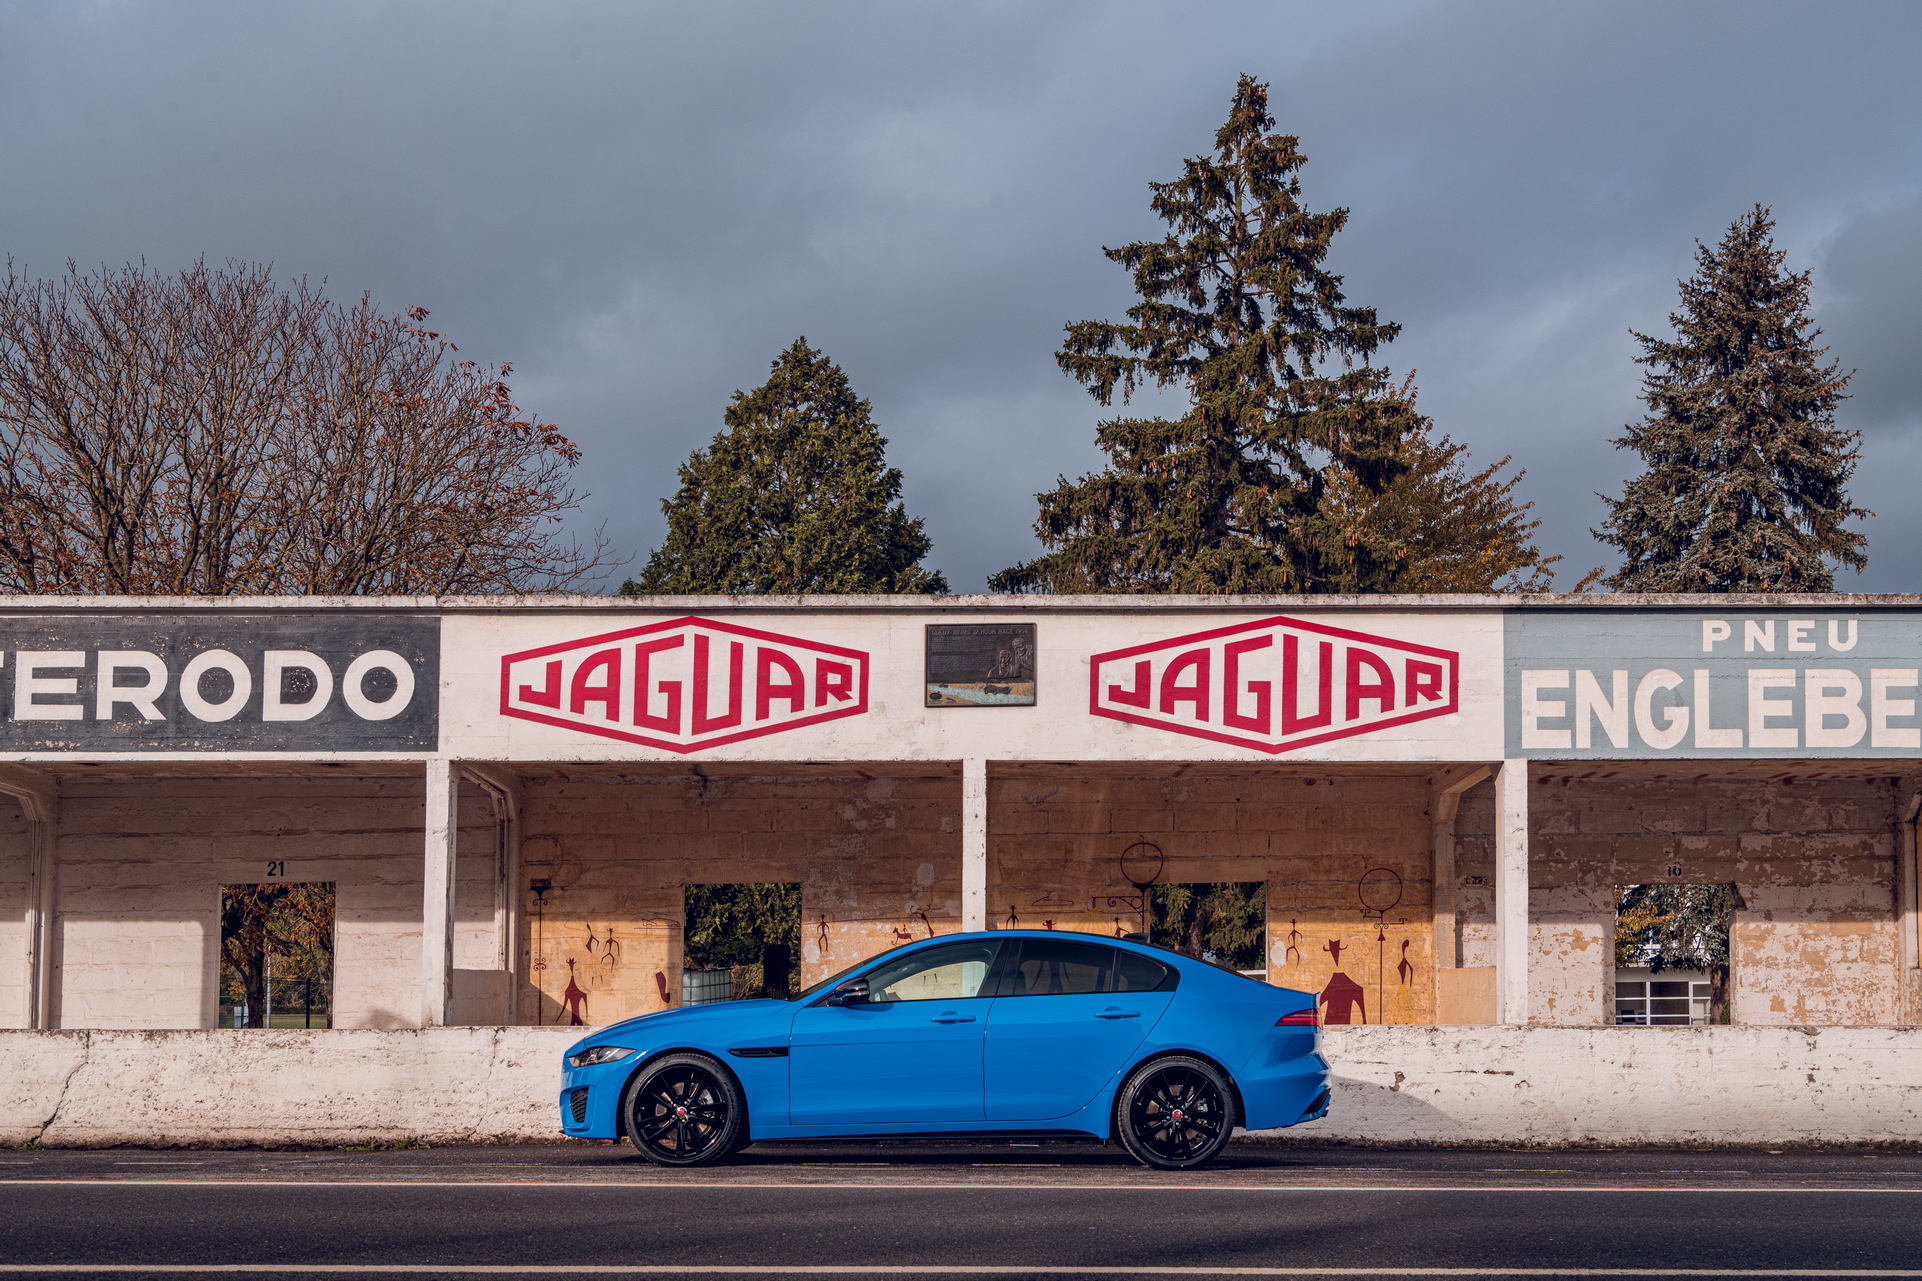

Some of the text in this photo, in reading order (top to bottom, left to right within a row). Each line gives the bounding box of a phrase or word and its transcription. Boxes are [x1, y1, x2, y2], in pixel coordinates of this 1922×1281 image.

[1702, 619, 1859, 652] PNEU
[0, 649, 415, 722] ERODO
[518, 633, 854, 736] JAGUAR
[1108, 633, 1444, 736] JAGUAR
[1521, 668, 1921, 750] ENGLEBE
[267, 861, 285, 877] 21
